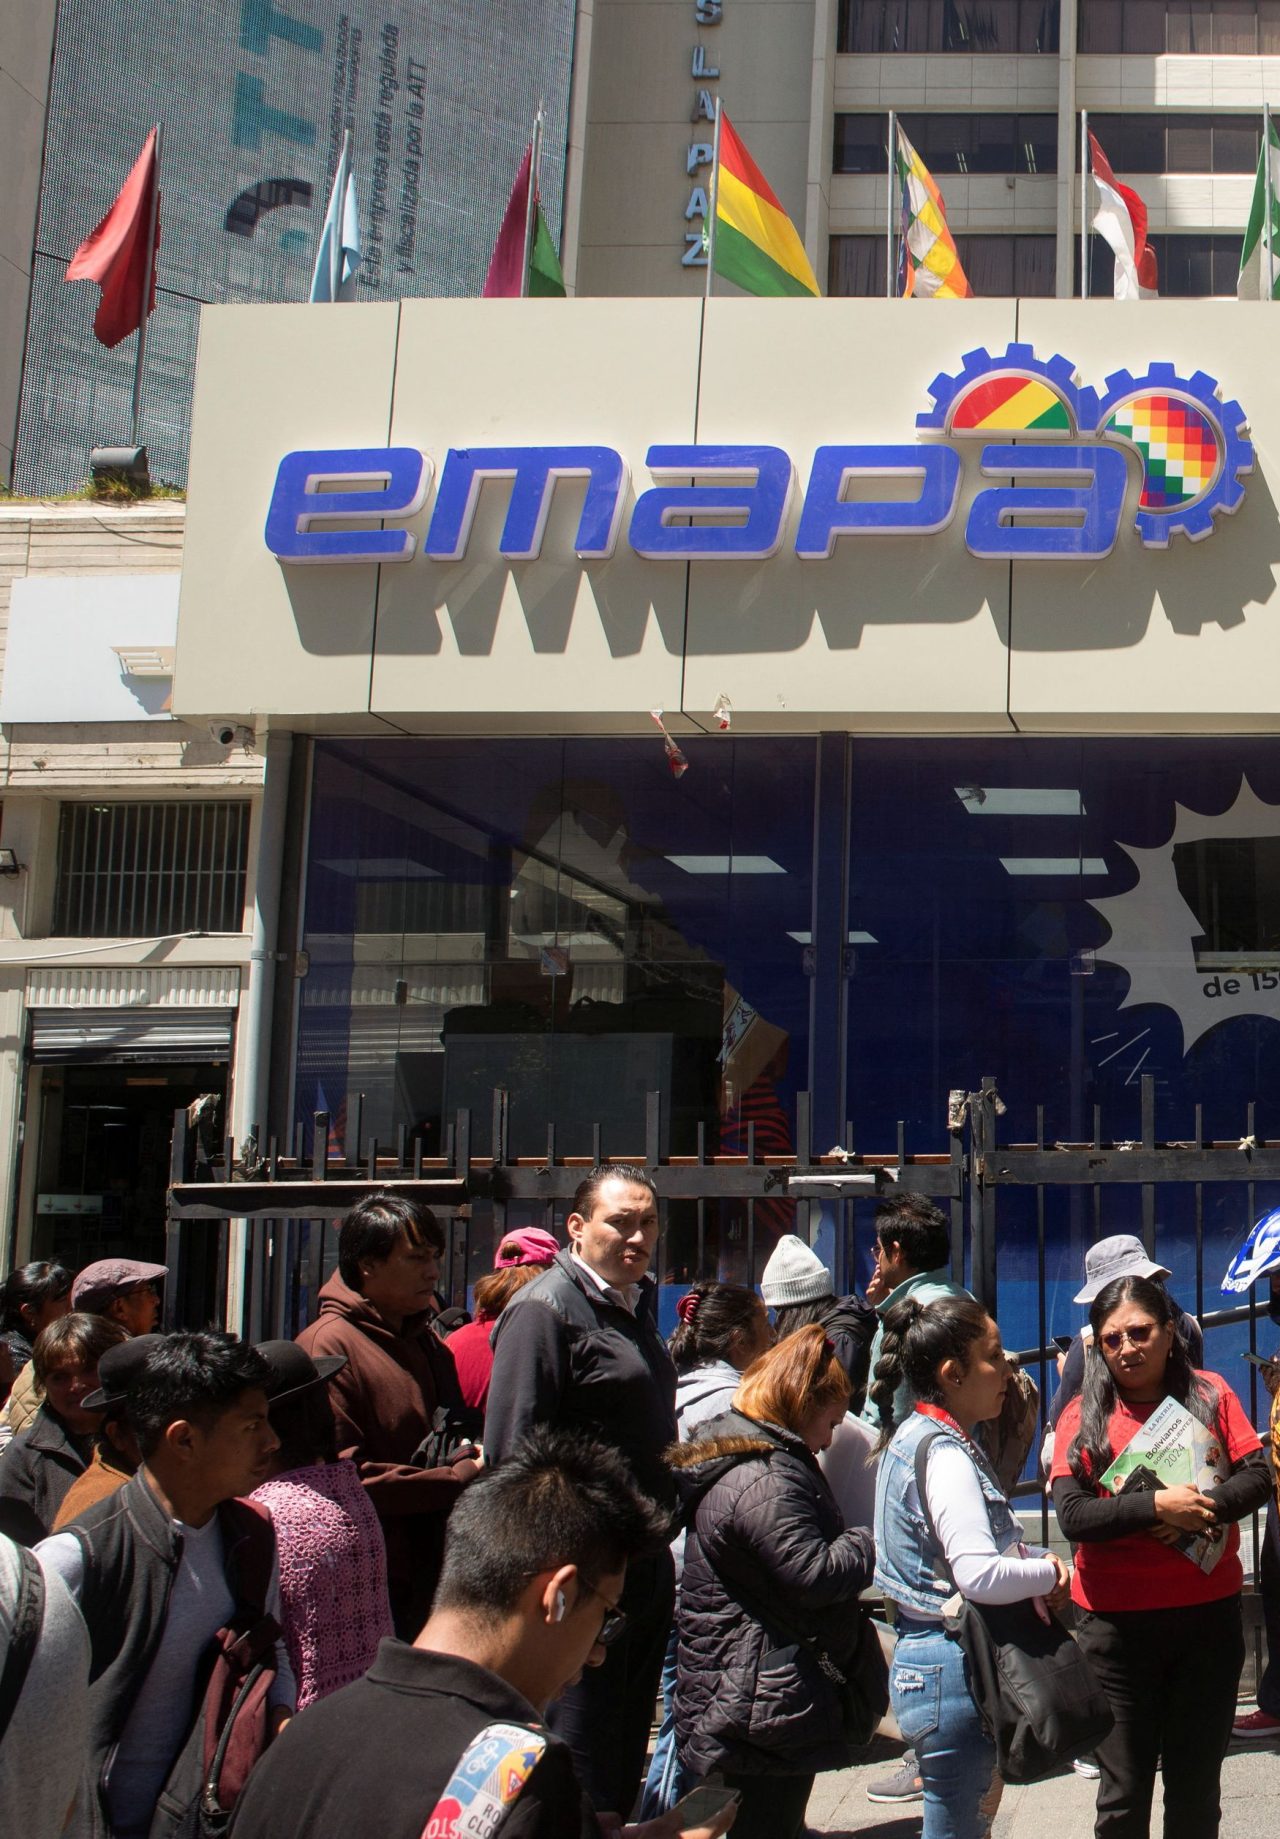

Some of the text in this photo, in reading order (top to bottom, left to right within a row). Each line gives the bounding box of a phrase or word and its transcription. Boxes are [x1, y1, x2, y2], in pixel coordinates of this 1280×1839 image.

[408, 57, 427, 100] ATT
[405, 102, 424, 119] la
[366, 158, 389, 241] empresa
[379, 24, 400, 109] regulada
[407, 121, 423, 156] por
[395, 160, 420, 258] fiscalizada
[265, 445, 1128, 560] emapa
[1203, 976, 1240, 998] de
[1156, 1402, 1174, 1424] PATRIA
[1145, 1418, 1182, 1460] Bolivianos
[1153, 1417, 1194, 1465] SOBRESALIENTES
[1163, 1443, 1186, 1468] 2024
